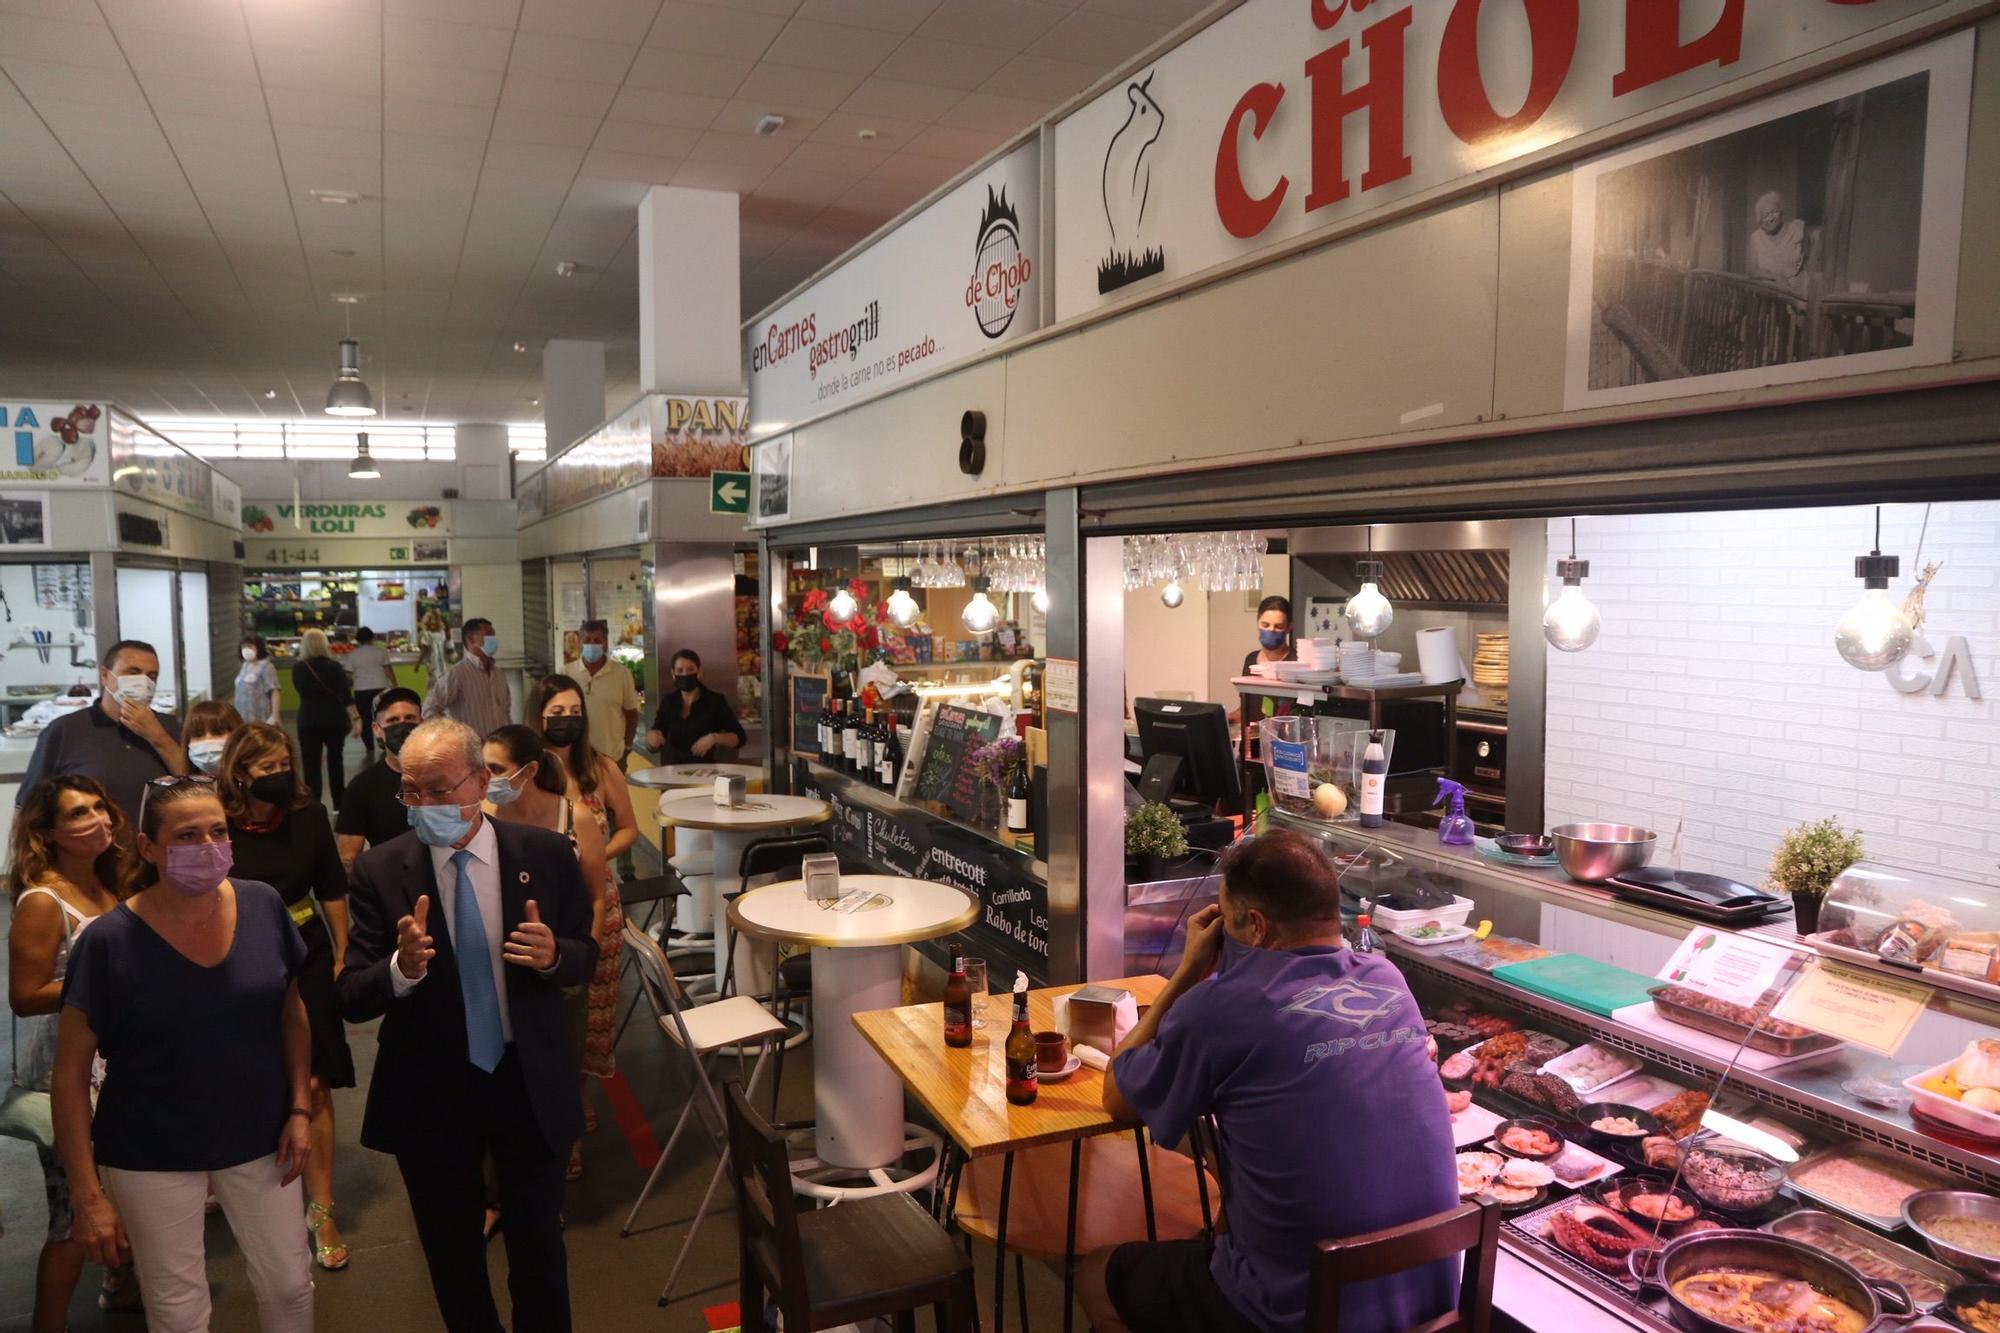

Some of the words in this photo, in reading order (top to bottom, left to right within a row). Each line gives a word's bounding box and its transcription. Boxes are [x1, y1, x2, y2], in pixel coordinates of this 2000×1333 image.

[1214, 0, 1905, 238] CHO
[966, 274, 982, 308] de
[986, 253, 1032, 309] Cholo
[809, 300, 880, 379] gastrogrill
[849, 367, 871, 388] carne
[873, 361, 884, 378] no
[886, 356, 896, 373] es
[958, 410, 987, 476] 8
[275, 503, 386, 519] VERDURAS
[310, 519, 355, 534] LOLI
[265, 547, 320, 564] 41-44
[992, 888, 1031, 905] Carrillada
[986, 905, 1012, 934] Rabo
[1014, 920, 1026, 943] de
[1303, 1037, 1357, 1063] RIP
[1359, 1026, 1422, 1050] CURL
